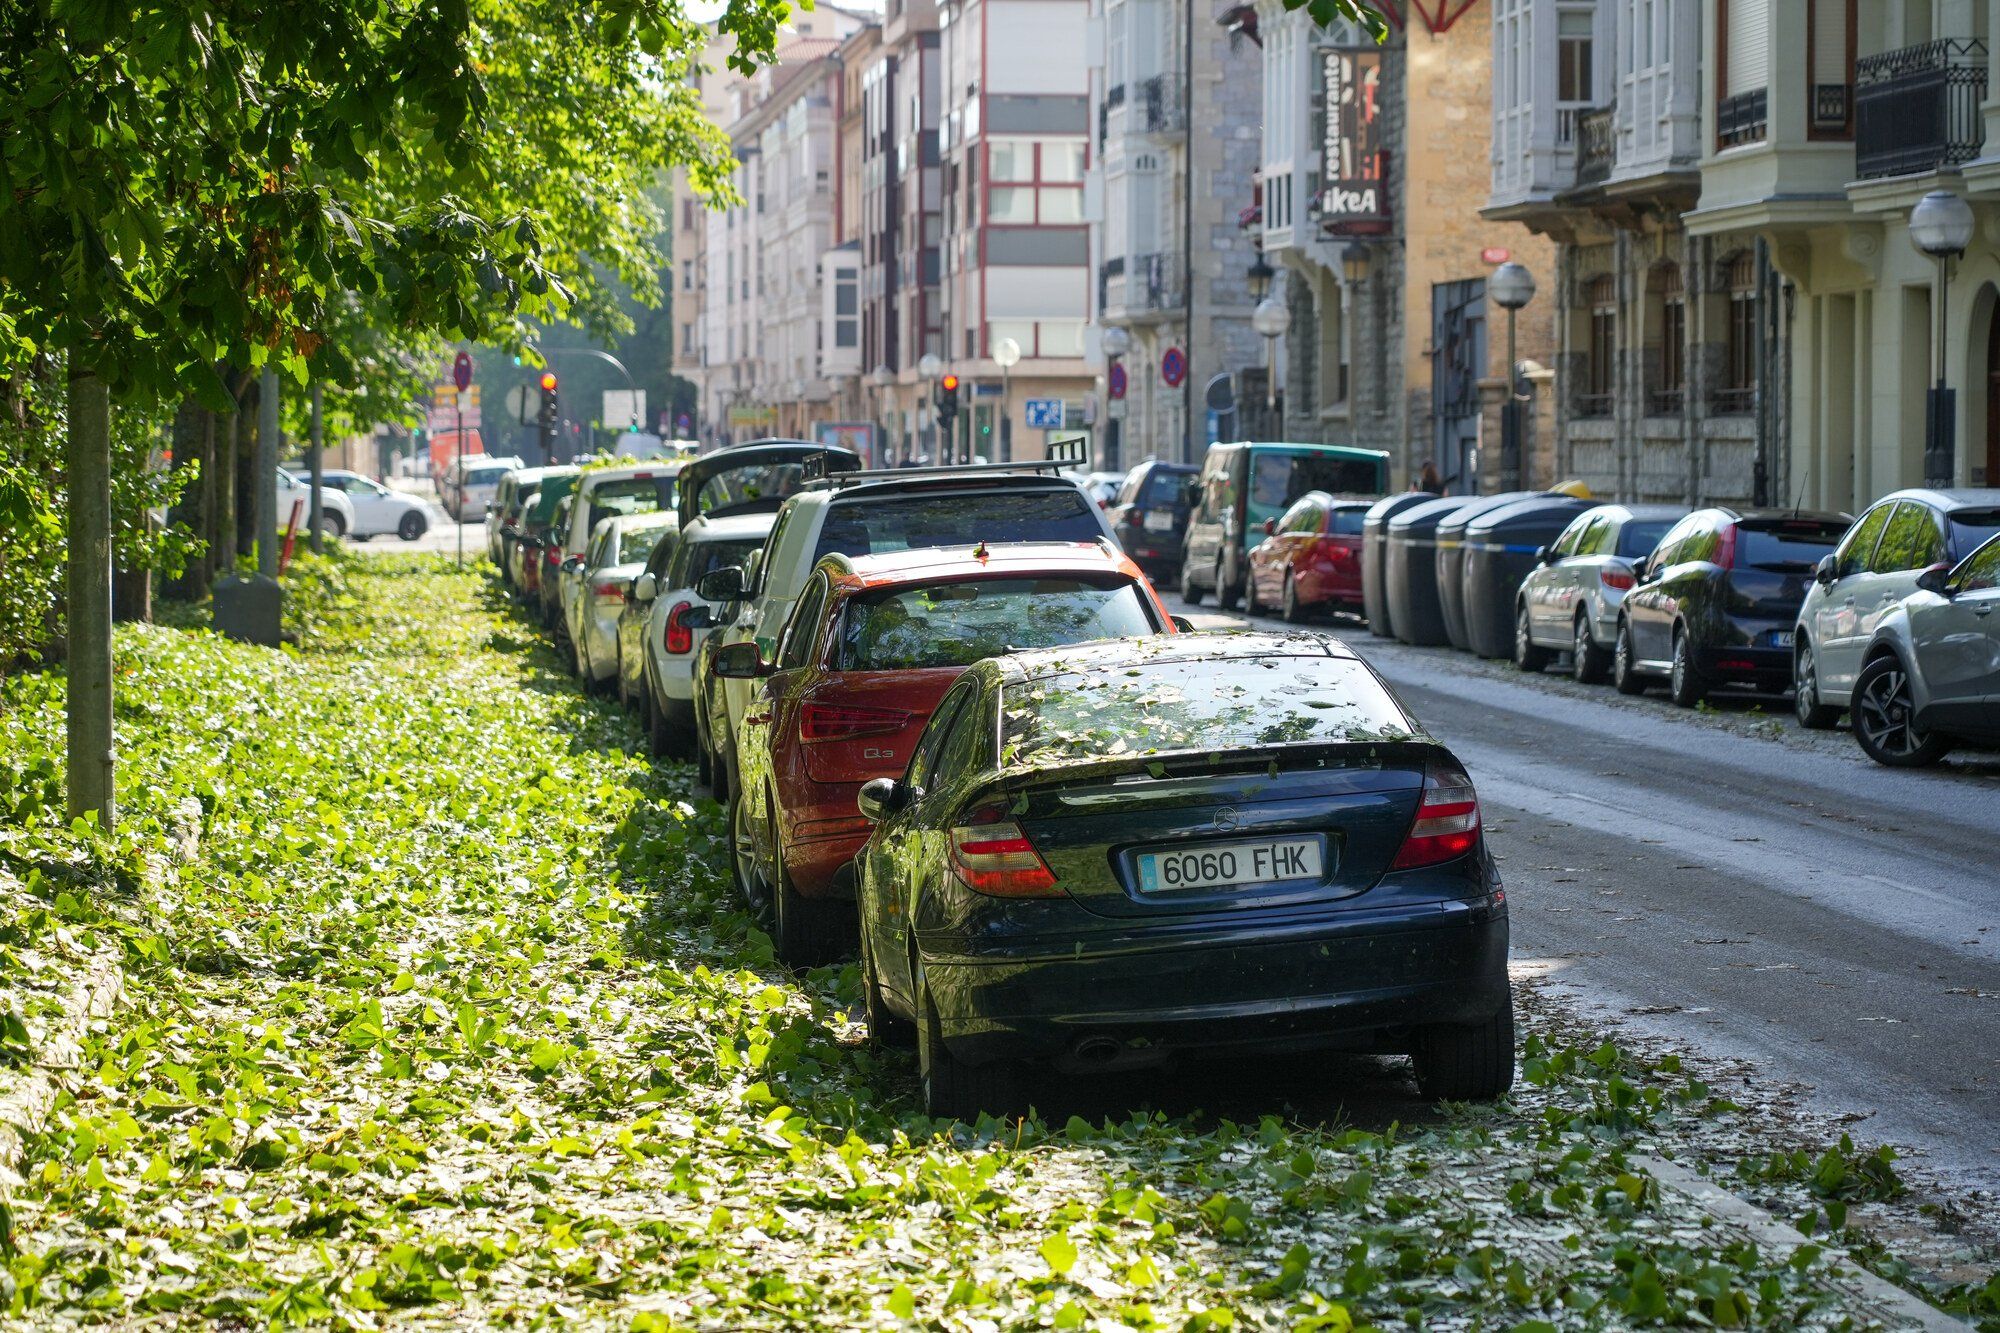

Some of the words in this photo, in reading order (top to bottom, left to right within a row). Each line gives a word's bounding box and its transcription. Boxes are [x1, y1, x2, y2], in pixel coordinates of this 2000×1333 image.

[1324, 53, 1340, 181] restaurante
[864, 748, 894, 759] Q3
[1163, 851, 1238, 885] 6060
[1252, 845, 1309, 878] FHK
